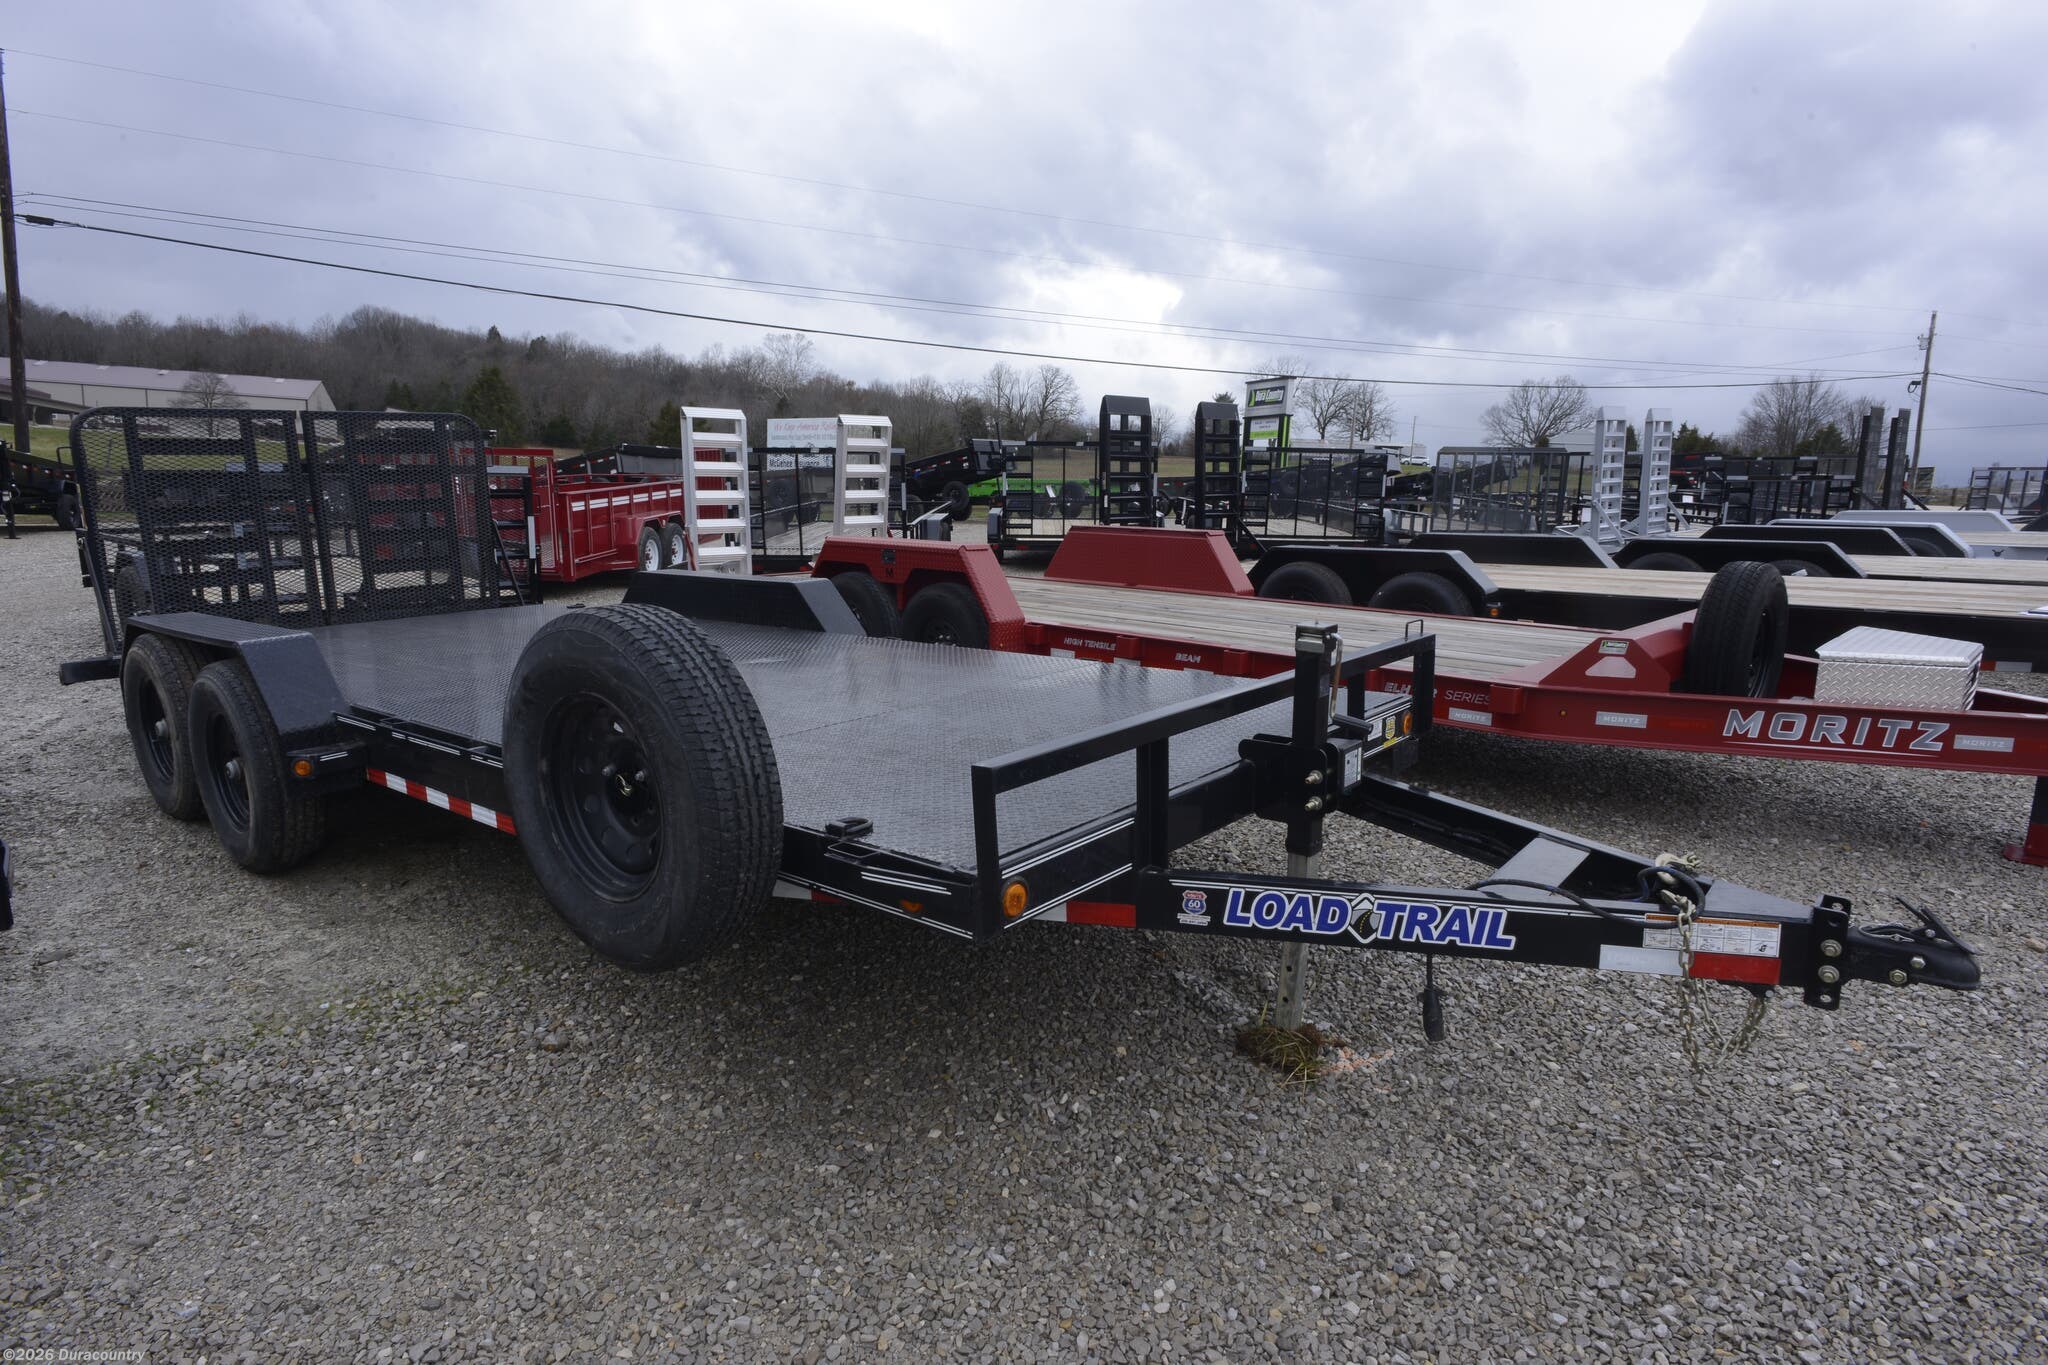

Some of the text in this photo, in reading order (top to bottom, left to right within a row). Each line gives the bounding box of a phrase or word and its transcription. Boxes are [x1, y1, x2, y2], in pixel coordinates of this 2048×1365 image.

[1064, 637, 1116, 650] HIGH TENSILE
[1175, 653, 1201, 663] BEAM
[1455, 712, 1487, 722] MORITZ
[1603, 715, 1641, 725] MORITZ
[1722, 708, 1950, 751] MORITZ
[1962, 738, 2006, 748] MORITZ
[1188, 899, 1201, 909] 60
[1224, 888, 1516, 950] LOAD TRAIL
